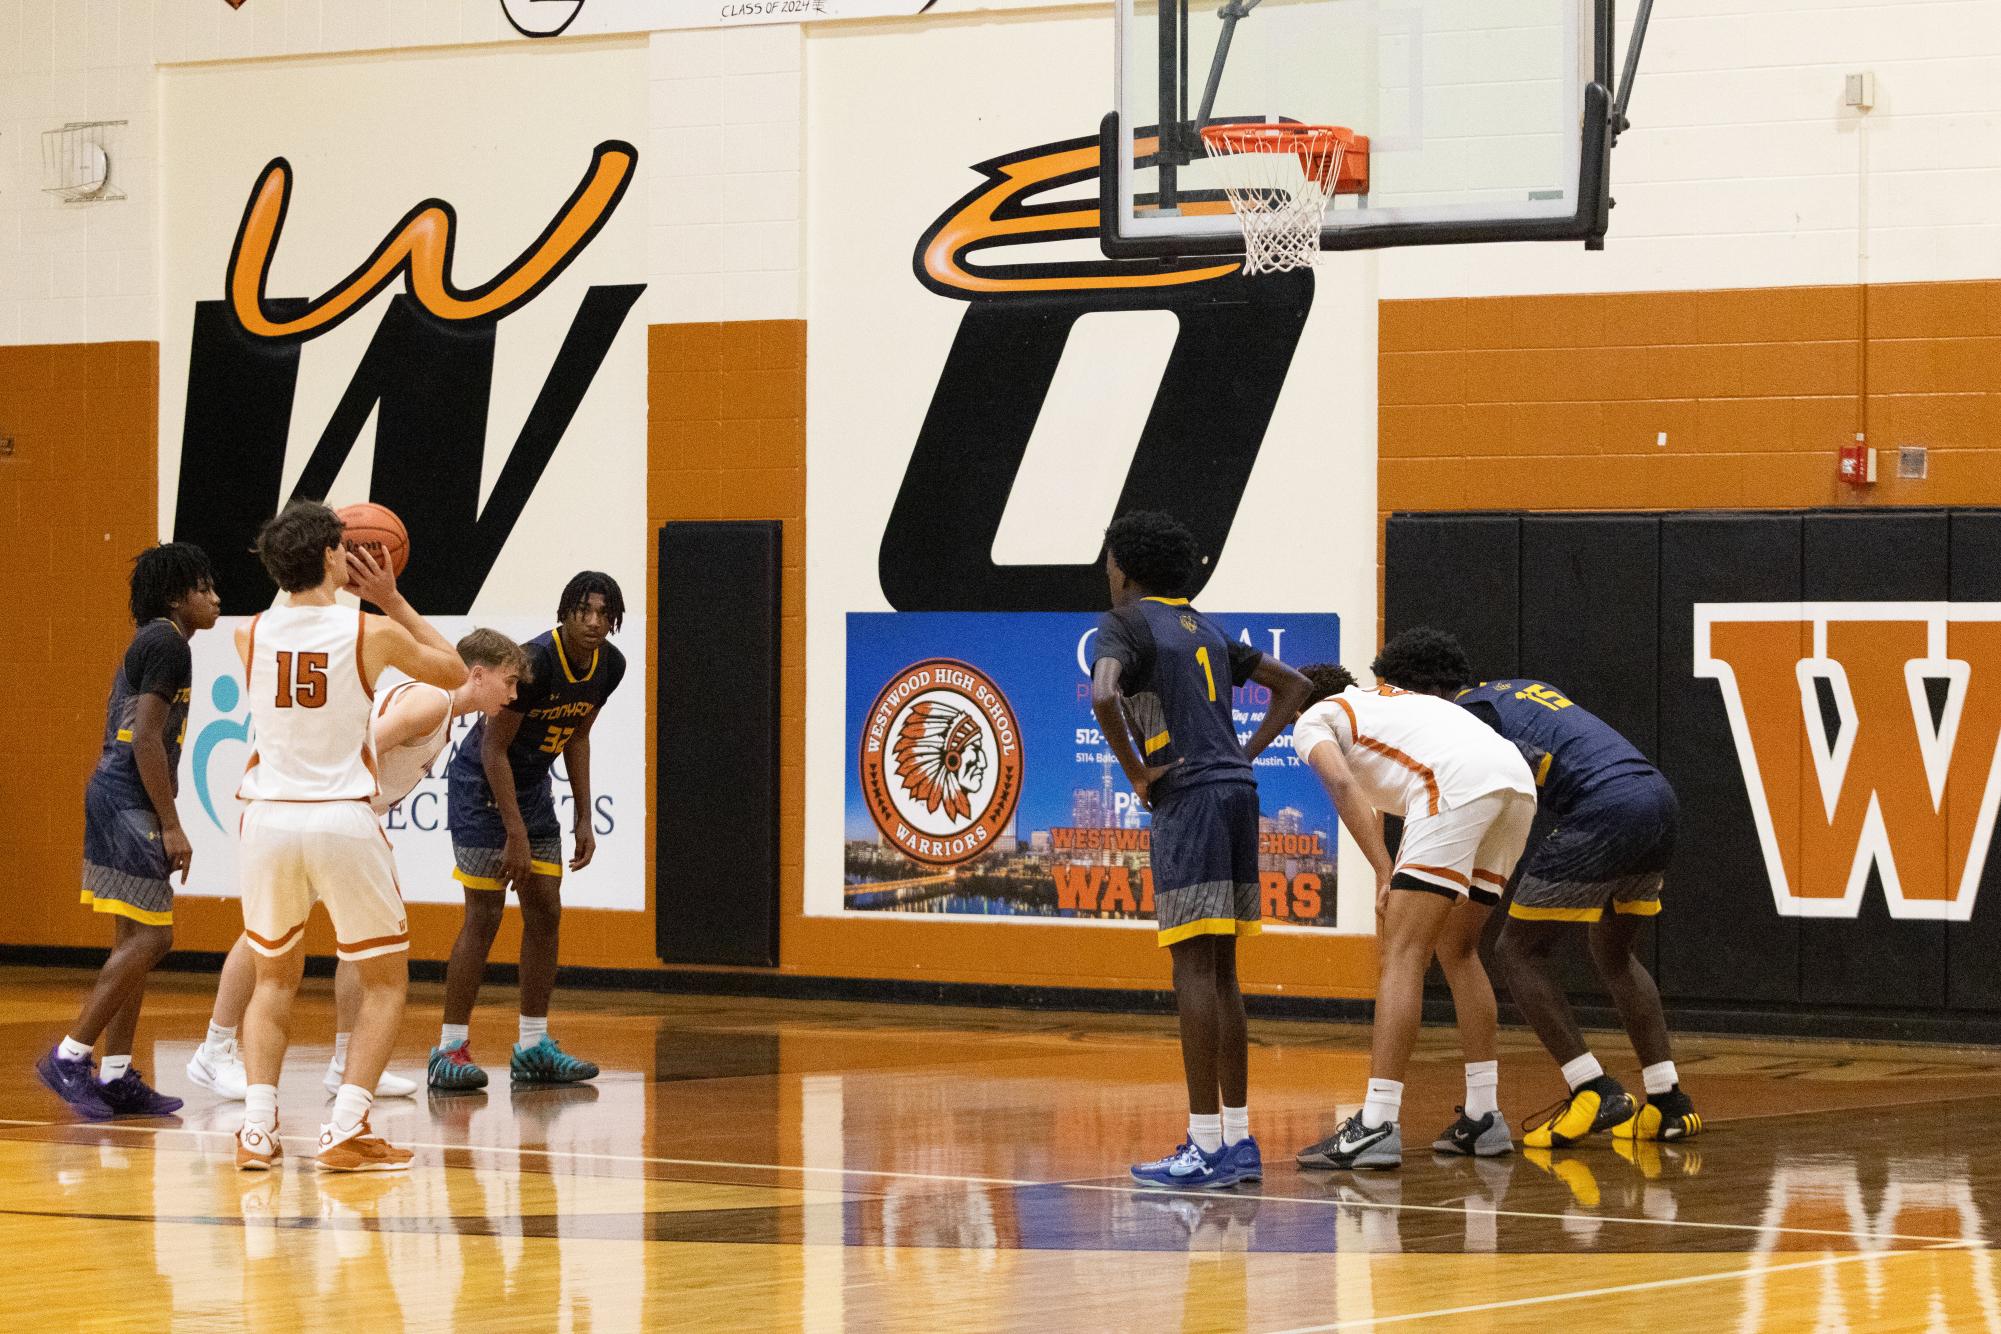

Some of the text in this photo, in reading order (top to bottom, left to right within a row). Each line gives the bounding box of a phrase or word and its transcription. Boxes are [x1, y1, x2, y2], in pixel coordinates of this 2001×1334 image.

[721, 2, 762, 18] CLASS
[765, 1, 780, 14] OF
[781, 0, 810, 13] 2024
[275, 651, 329, 709] 15
[1195, 646, 1216, 702] 1
[867, 668, 1017, 756] WESTWOOD HIGH SCHOOL
[539, 725, 575, 753] 32
[1286, 757, 1301, 767] TX
[1693, 601, 2001, 921] W
[895, 822, 988, 857] WARRIORS
[1050, 828, 1151, 850] WESTWO
